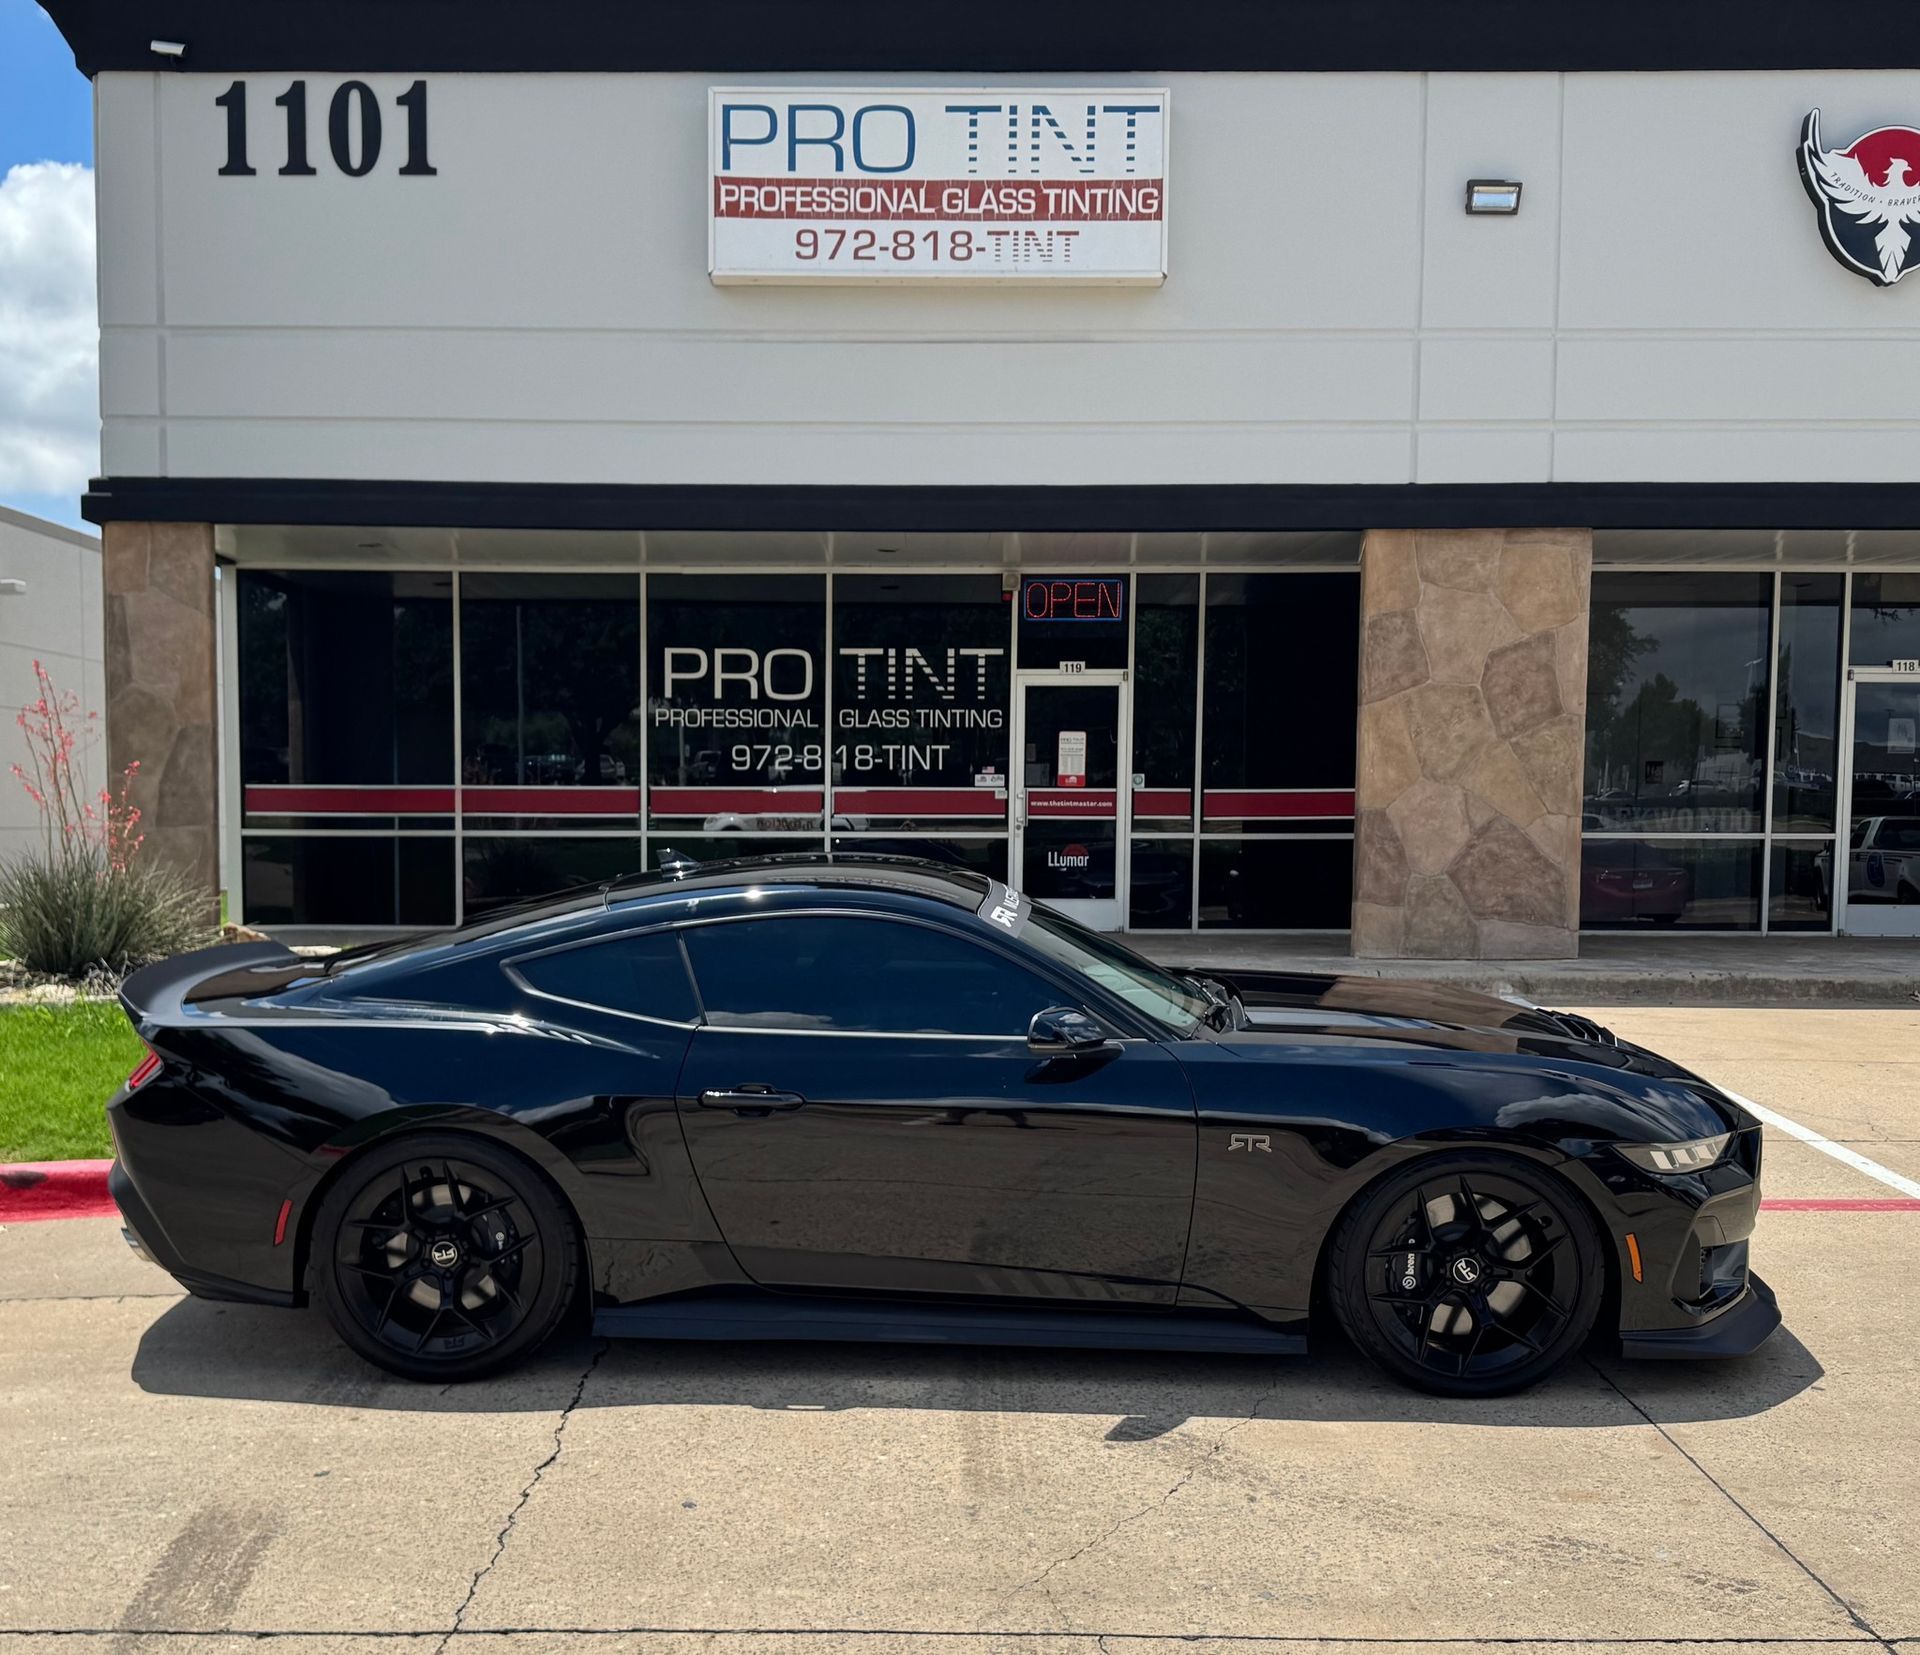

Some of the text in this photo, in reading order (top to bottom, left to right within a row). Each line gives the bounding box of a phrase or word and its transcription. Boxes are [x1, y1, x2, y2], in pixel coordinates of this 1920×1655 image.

[216, 81, 437, 177] 1101
[722, 104, 1160, 173] PRO TINT
[720, 184, 1159, 215] PROFESSIONAL GLASS TINTING
[1831, 171, 1876, 204] TRADITION
[795, 229, 1079, 262] 972-818-TINT
[1026, 582, 1120, 618] OPEN
[664, 647, 1004, 700] PRO TINT
[1064, 663, 1082, 673] 119
[1897, 661, 1915, 672] 118
[655, 708, 1003, 729] PROFESSIONAL GLASS TINTING
[1048, 851, 1090, 867] LLumar
[1227, 1133, 1272, 1153] RTR
